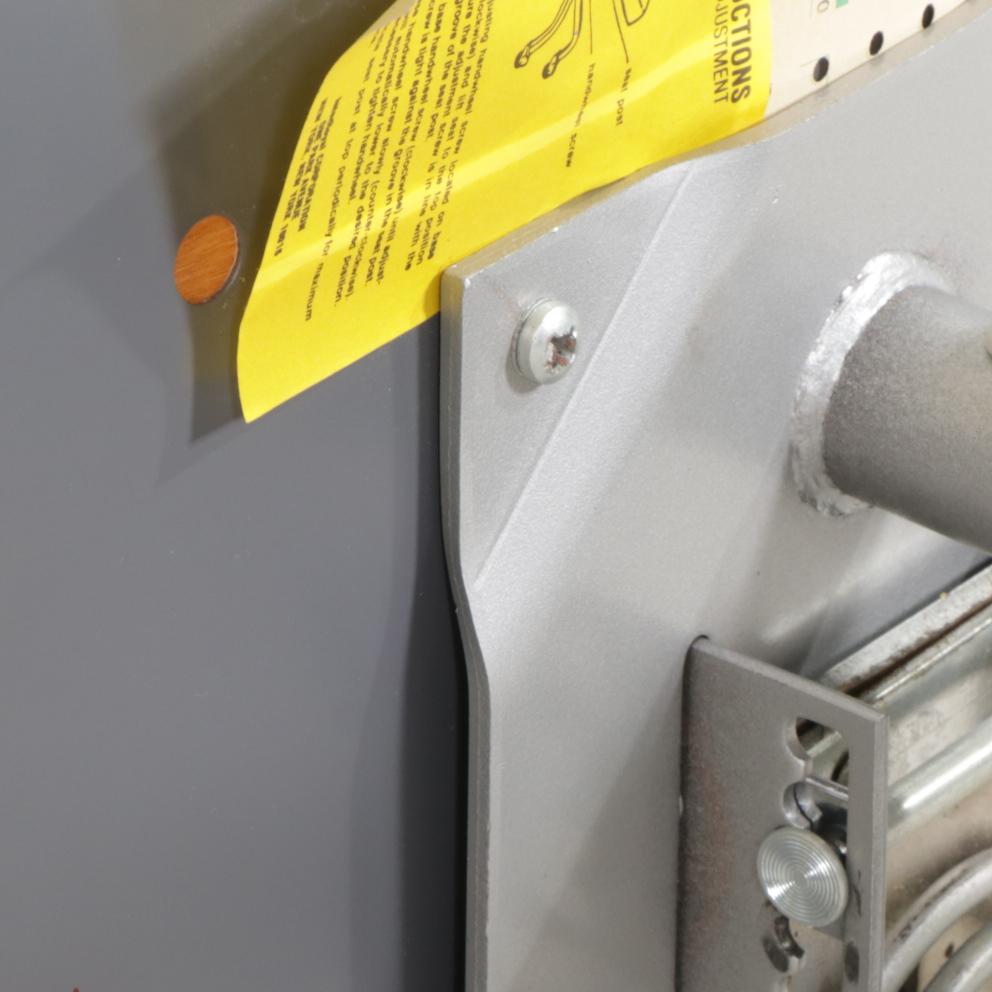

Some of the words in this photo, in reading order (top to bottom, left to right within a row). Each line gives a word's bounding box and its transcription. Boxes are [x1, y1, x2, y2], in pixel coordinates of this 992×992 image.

[433, 3, 446, 33] base
[713, 0, 729, 104] JUSTMENT
[730, 0, 753, 104] CTIONS
[615, 98, 625, 127] post
[565, 132, 577, 168] screw
[426, 232, 441, 260] base
